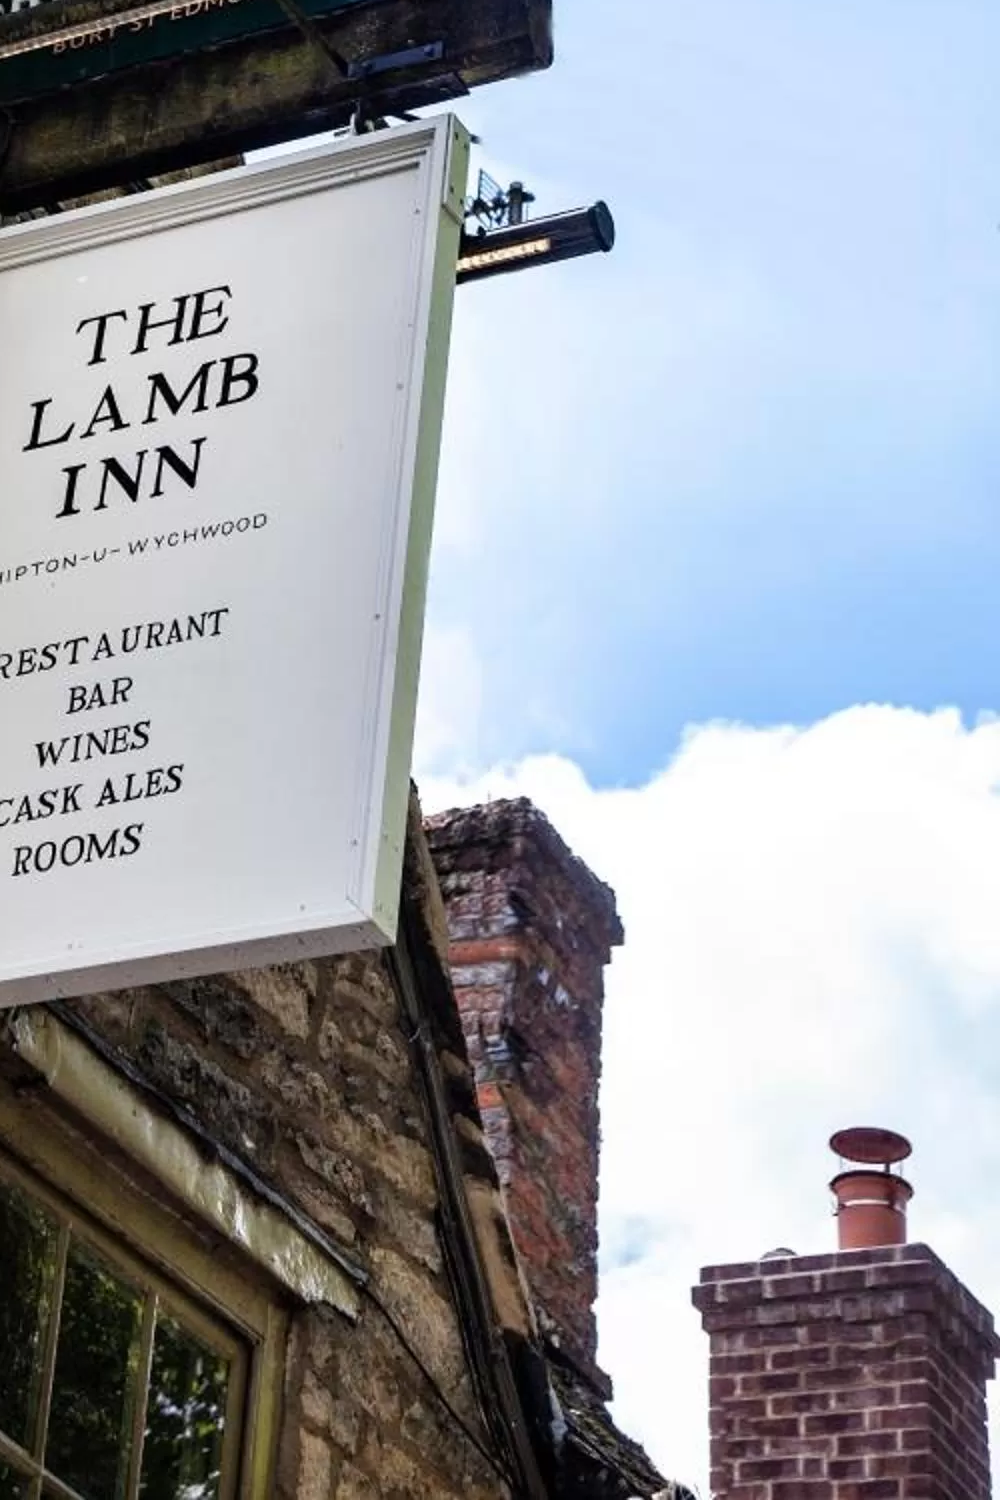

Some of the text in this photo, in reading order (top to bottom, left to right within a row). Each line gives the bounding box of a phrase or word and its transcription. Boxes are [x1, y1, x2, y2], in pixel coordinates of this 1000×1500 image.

[76, 285, 232, 366] THE
[22, 353, 258, 452] LAMB
[55, 437, 207, 518] INN
[66, 677, 133, 714] BAR
[35, 720, 150, 768] WINES
[96, 764, 184, 808] ALES
[12, 823, 144, 876] ROOMS
